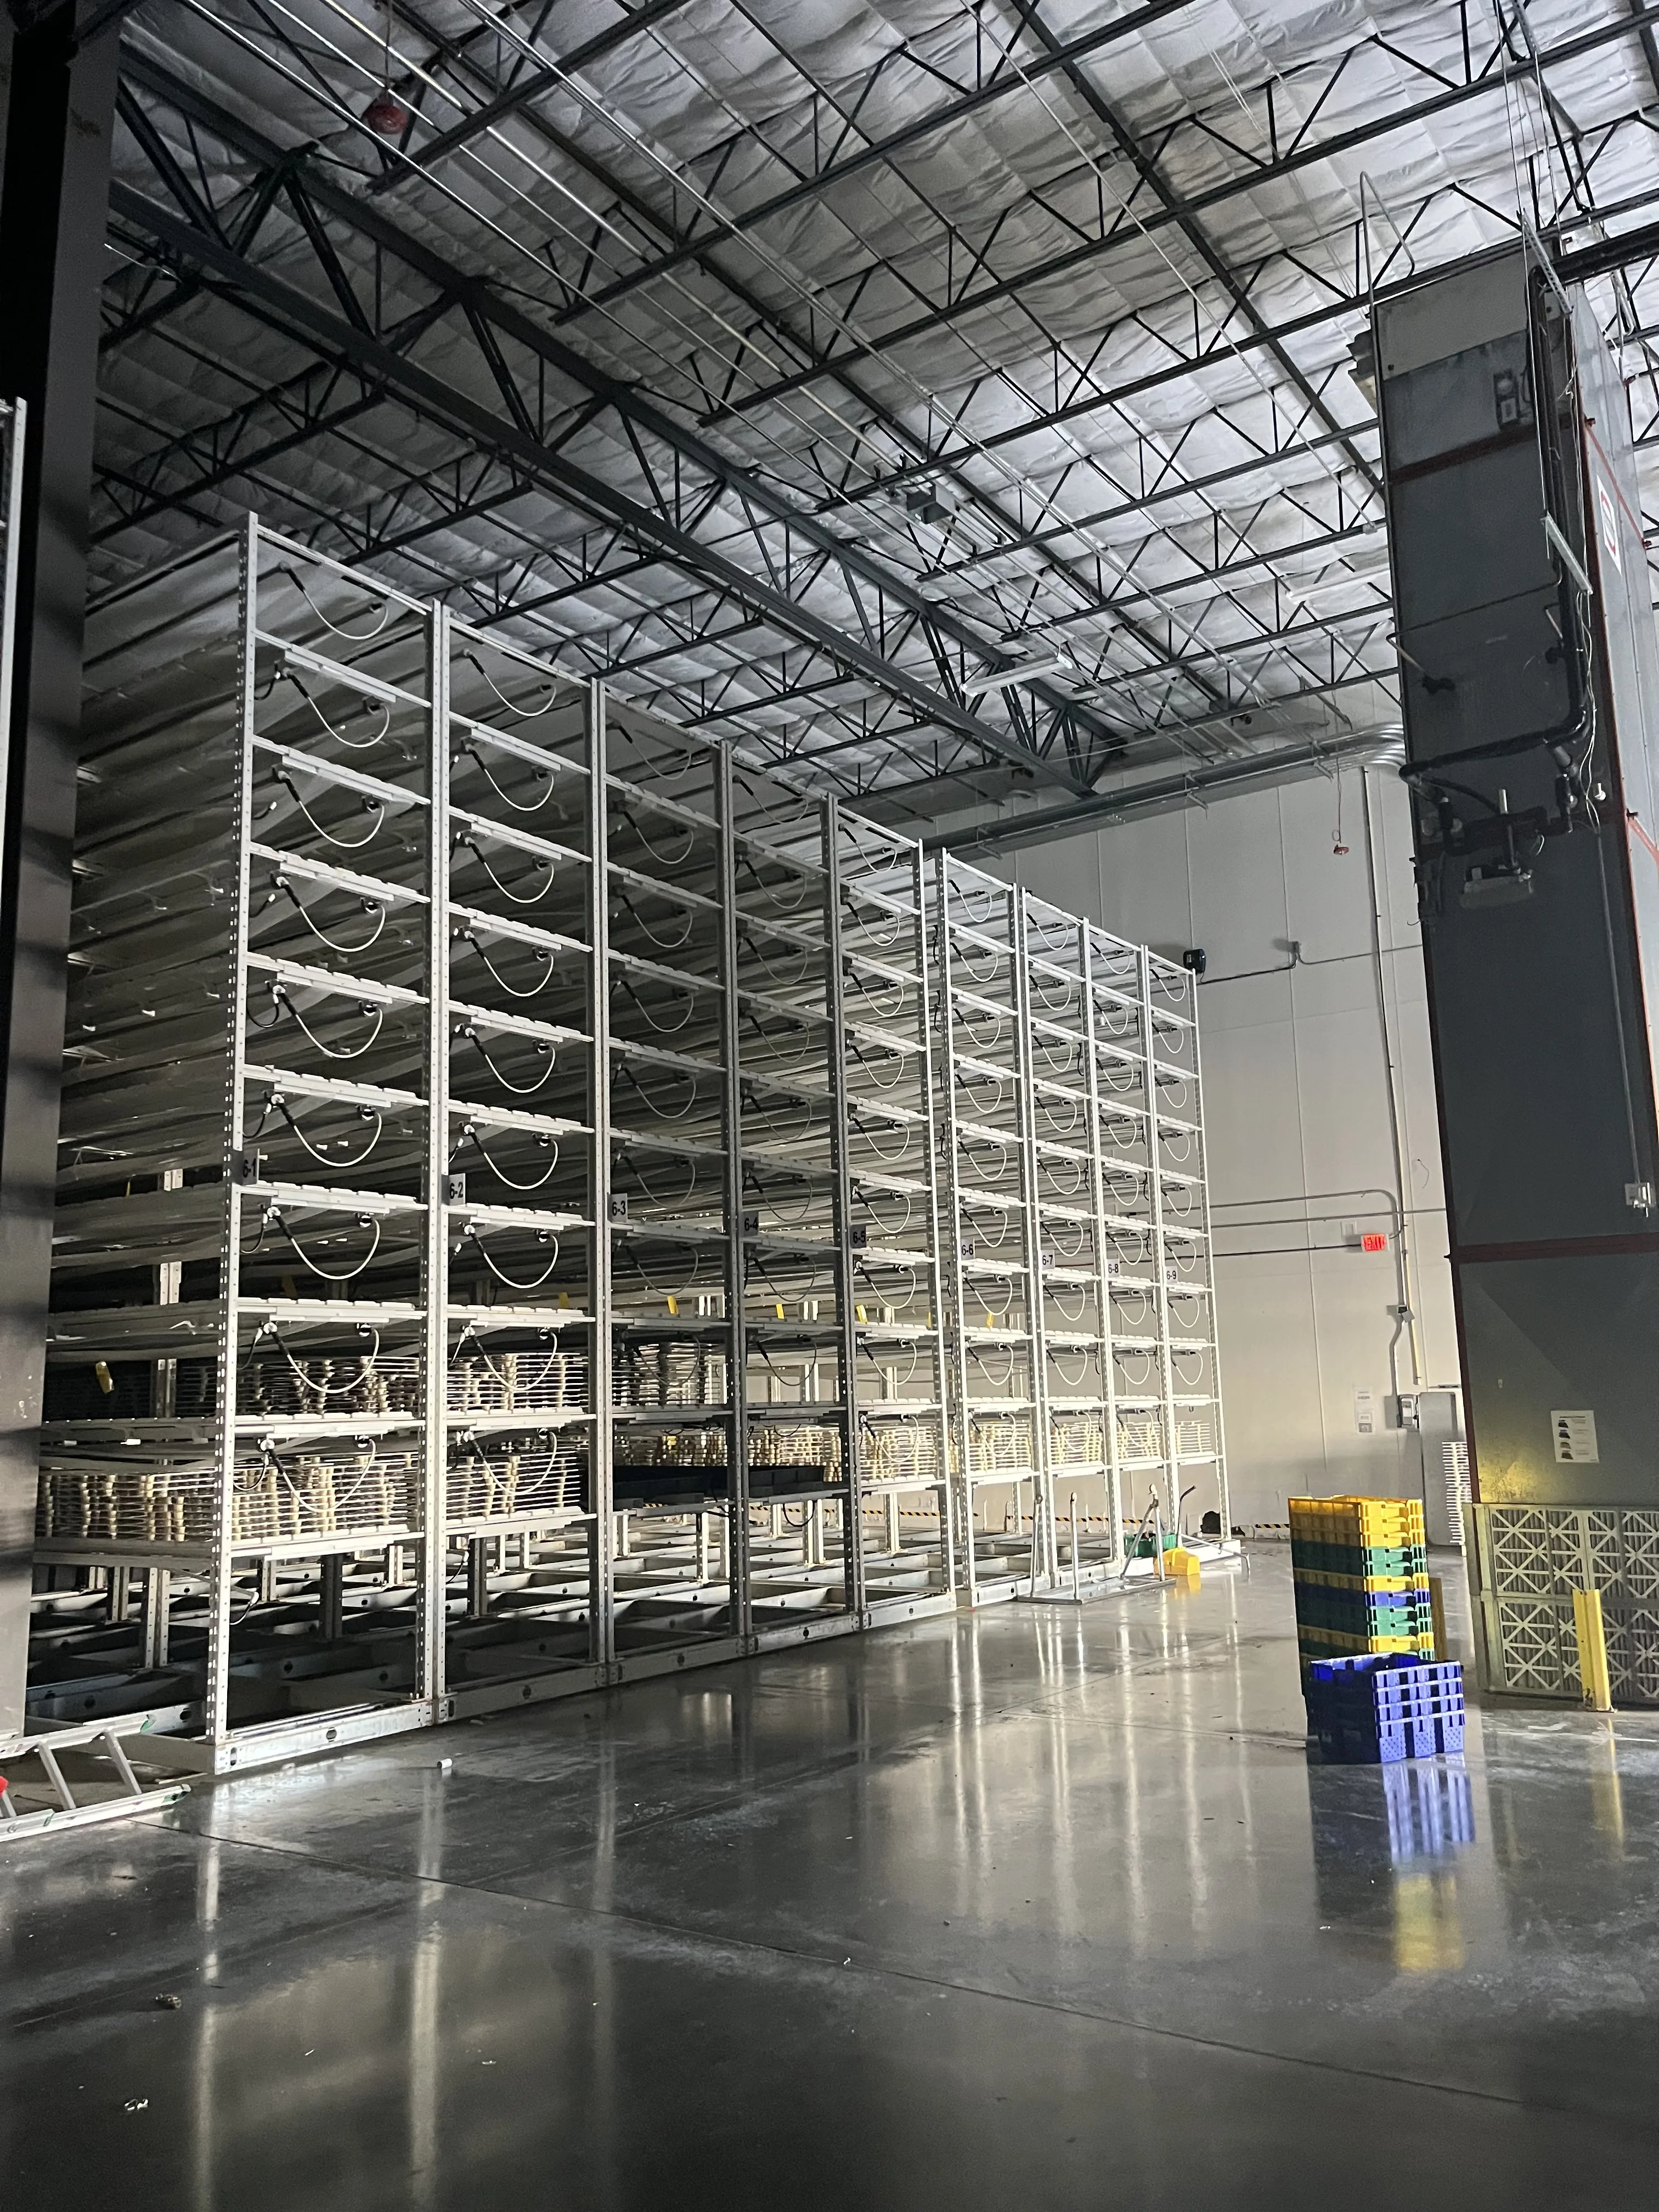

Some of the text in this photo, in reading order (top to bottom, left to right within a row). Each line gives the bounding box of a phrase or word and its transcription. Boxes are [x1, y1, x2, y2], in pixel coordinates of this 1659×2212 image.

[243, 1158, 257, 1178] 6-1
[449, 1181, 464, 1199] 6-2
[612, 1200, 626, 1216] 6-3
[744, 1217, 759, 1231] 6-4
[853, 1231, 866, 1244] 6-5
[1364, 1234, 1385, 1250] EXIT
[961, 1244, 974, 1256] 6-6
[1042, 1254, 1053, 1266] 6-7
[1108, 1263, 1119, 1274] 6-8
[1166, 1270, 1177, 1280] 6-9
